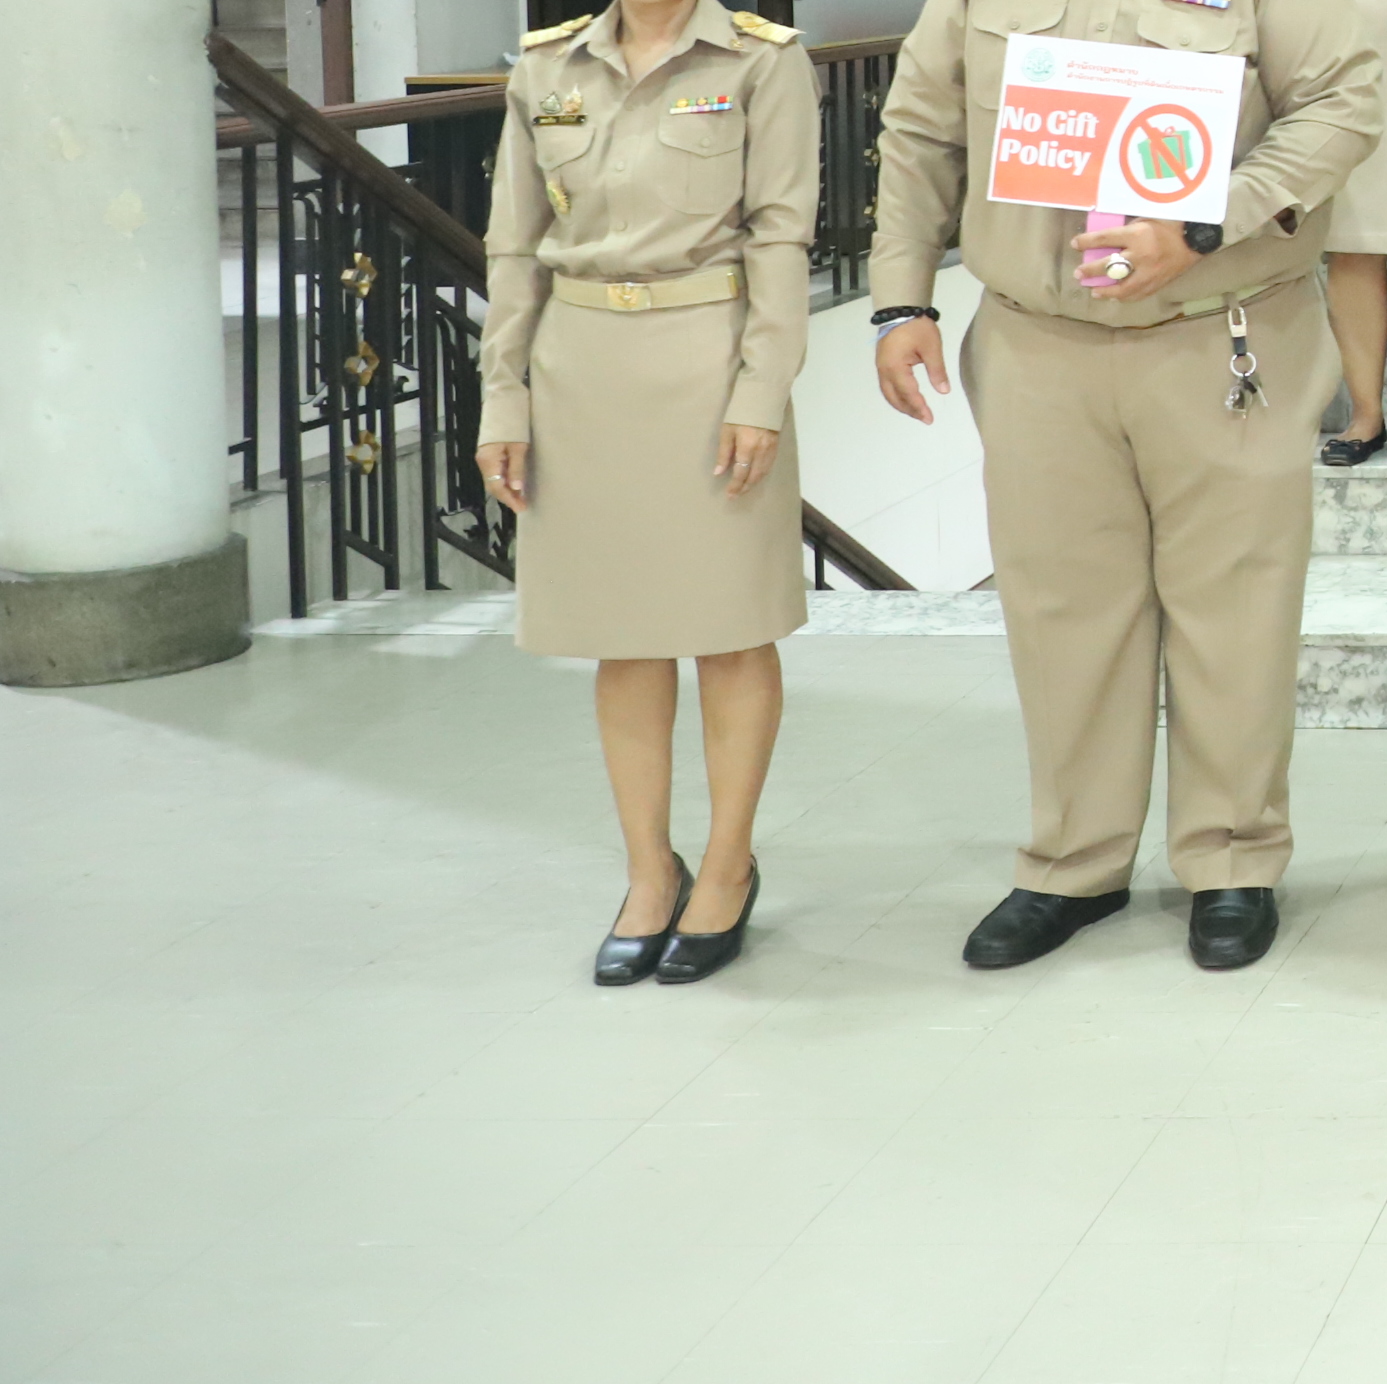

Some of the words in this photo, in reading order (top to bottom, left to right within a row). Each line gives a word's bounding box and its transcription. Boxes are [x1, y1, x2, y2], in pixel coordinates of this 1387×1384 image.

[1001, 105, 1042, 132] No
[1046, 109, 1100, 138] Gift
[999, 138, 1092, 176] Policy
